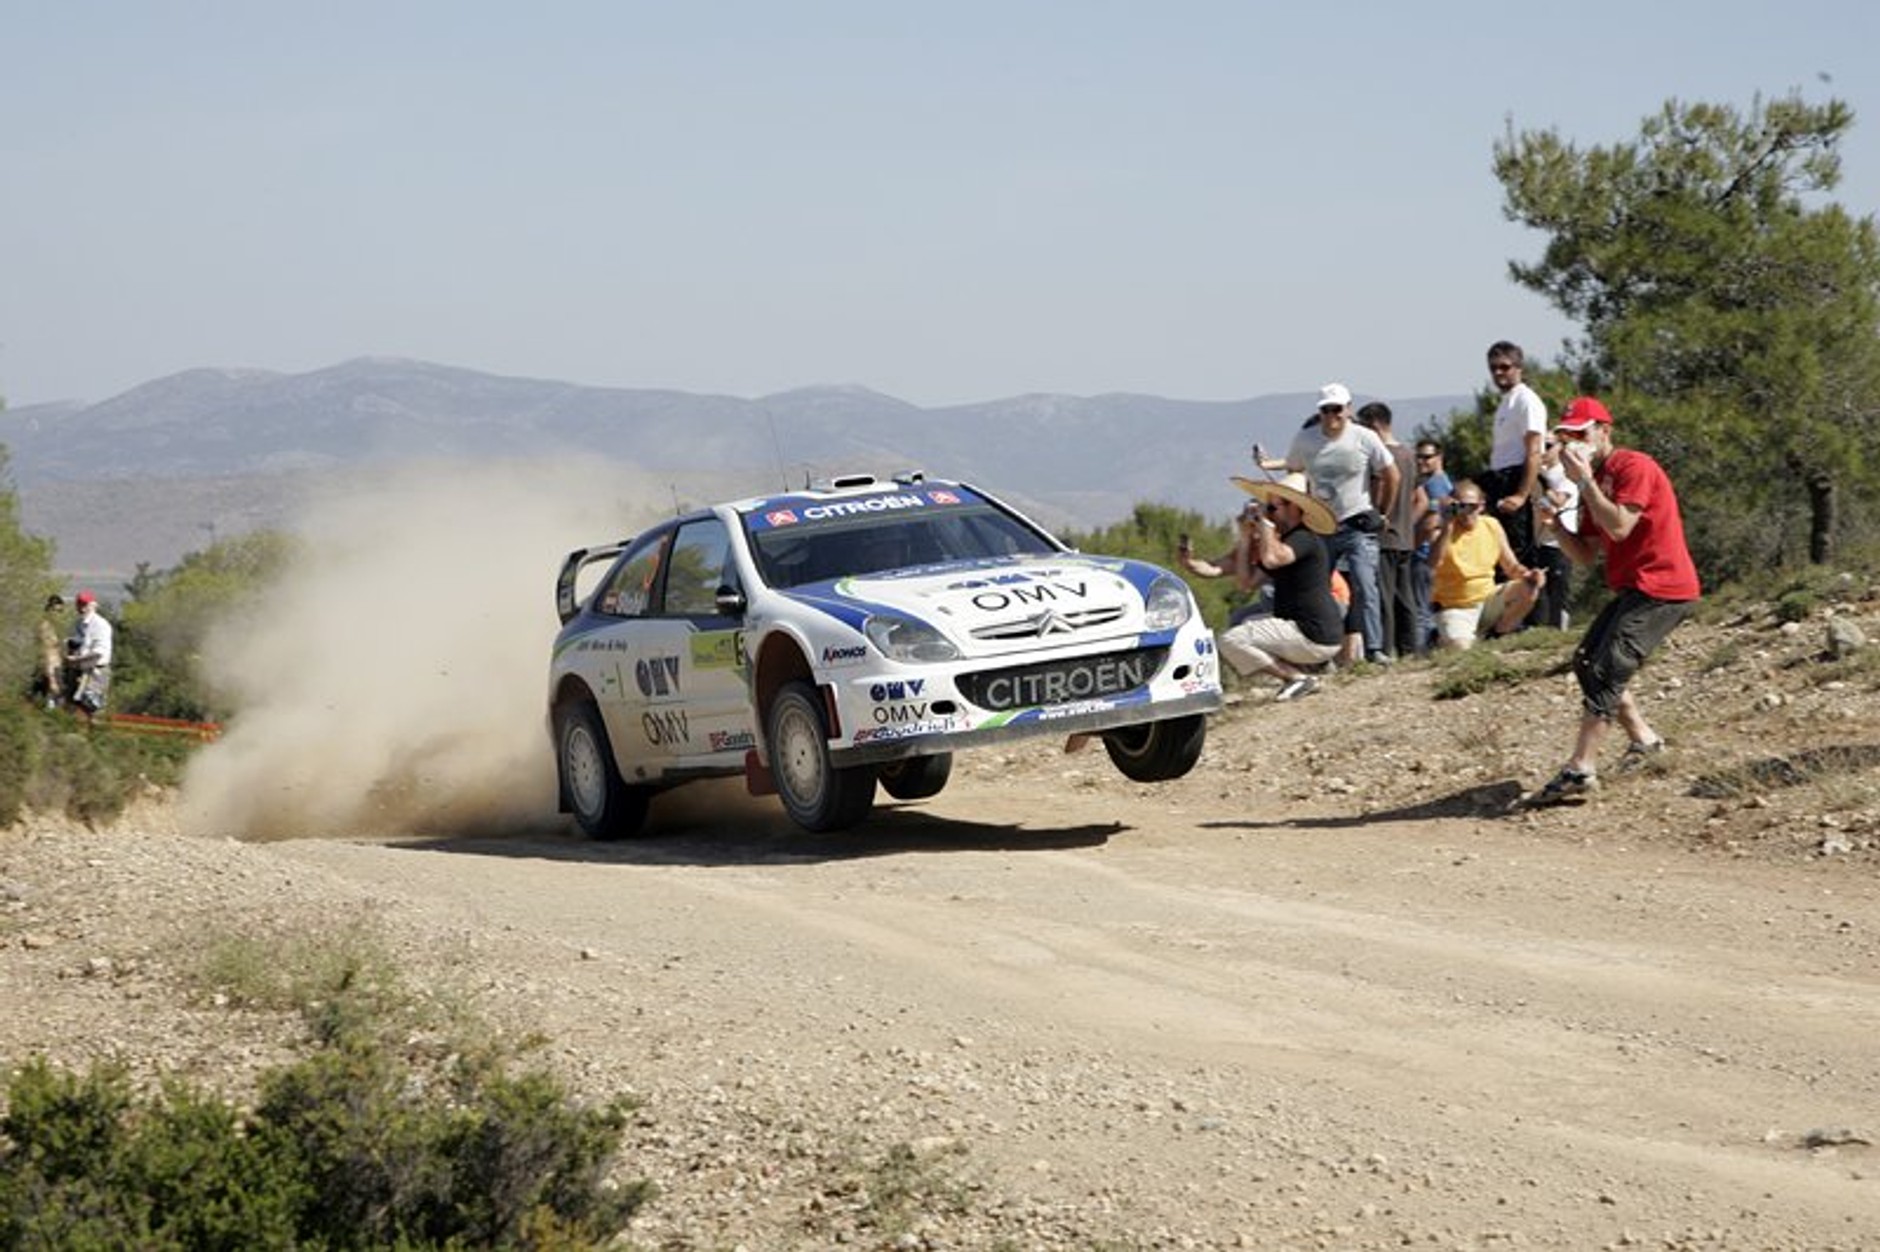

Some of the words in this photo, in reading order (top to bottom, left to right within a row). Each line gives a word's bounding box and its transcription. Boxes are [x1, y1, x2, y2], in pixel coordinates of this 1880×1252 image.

[804, 495, 924, 519] CITROËN
[972, 582, 1086, 611] OMV
[986, 657, 1144, 708] CITROËN
[642, 709, 690, 746] OMV
[873, 702, 928, 724] OMV
